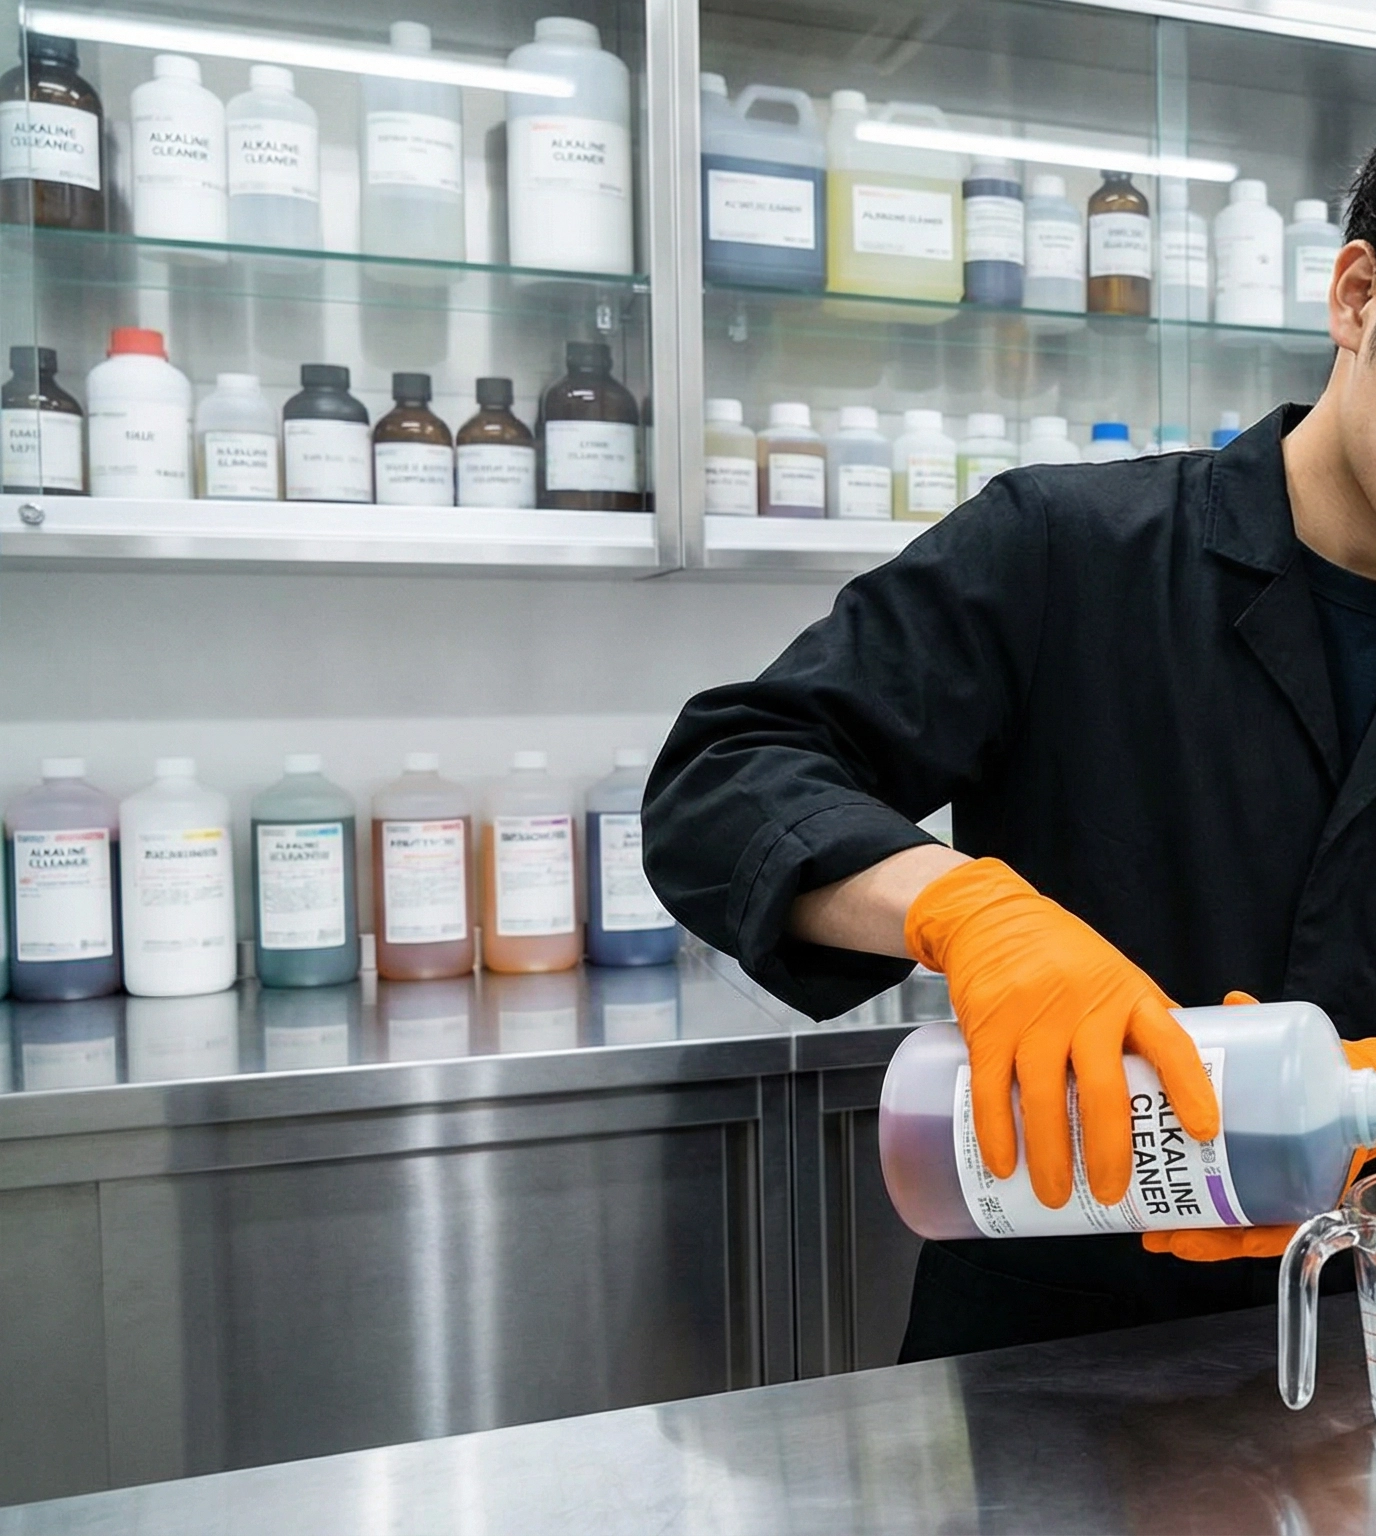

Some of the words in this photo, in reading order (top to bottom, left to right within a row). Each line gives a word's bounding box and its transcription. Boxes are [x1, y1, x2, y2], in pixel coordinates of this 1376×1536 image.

[14, 122, 77, 139] ALKALINE
[149, 132, 208, 147] ALKALINE
[551, 139, 606, 152] ALKALINE
[152, 145, 208, 161] CLEANER
[241, 140, 299, 154] ALKALINE
[244, 153, 298, 167] CLEANER
[553, 151, 605, 165] CLEANER
[1130, 1093, 1171, 1215] CLEANER
